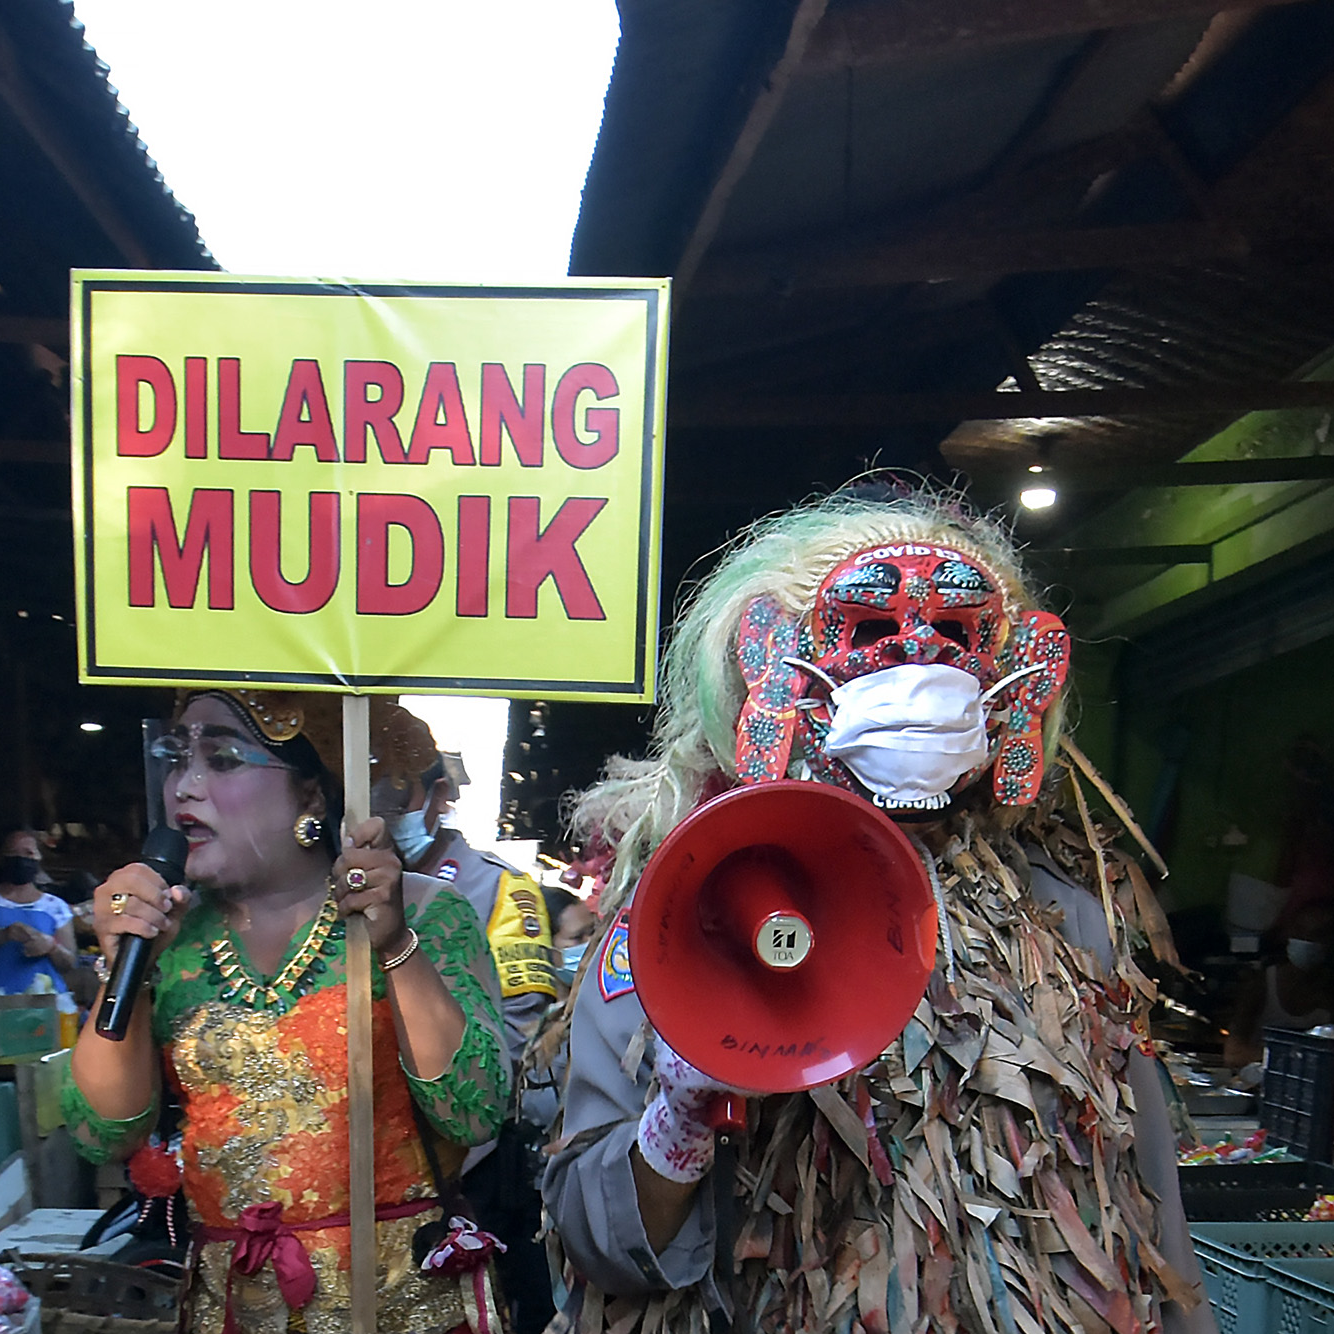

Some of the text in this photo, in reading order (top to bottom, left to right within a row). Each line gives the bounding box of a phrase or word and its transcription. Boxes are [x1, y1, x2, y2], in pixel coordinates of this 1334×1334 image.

[116, 355, 620, 470] DILARANG
[126, 485, 609, 621] MUDIK
[773, 951, 794, 961] TOA
